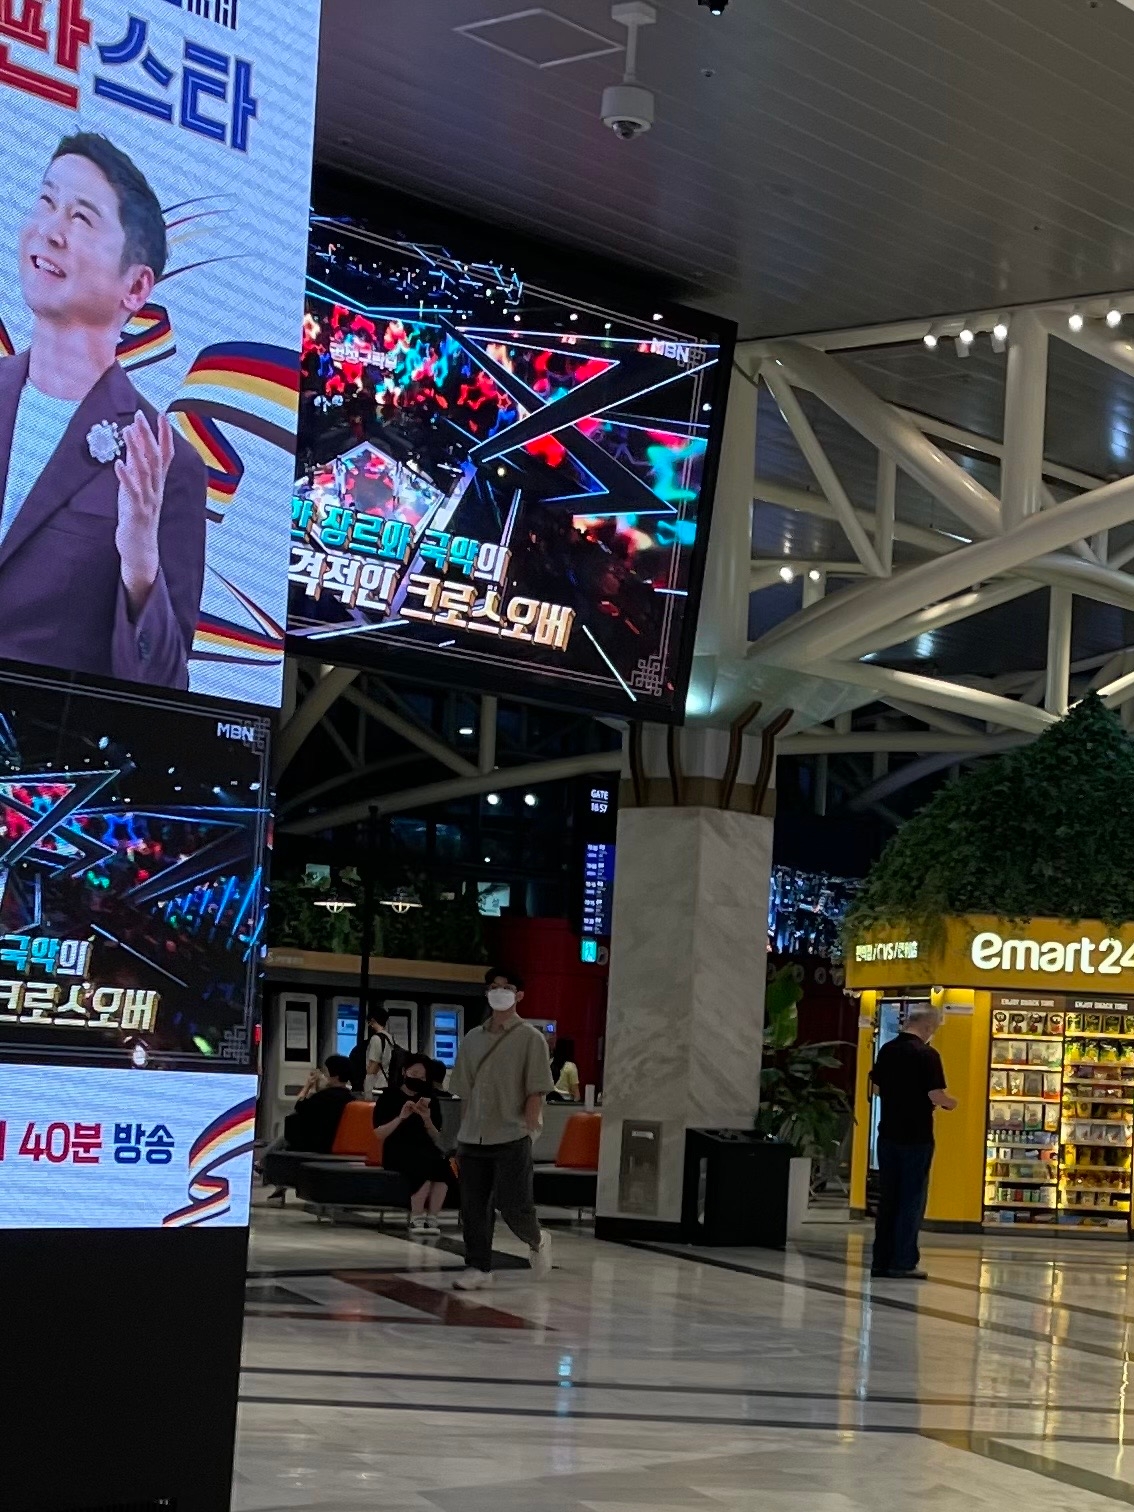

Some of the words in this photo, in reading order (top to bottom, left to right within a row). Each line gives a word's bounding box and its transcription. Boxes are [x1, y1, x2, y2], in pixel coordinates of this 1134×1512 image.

[654, 337, 689, 362] MBN
[321, 504, 414, 562] 장르와
[420, 528, 511, 582] 국악의
[400, 573, 575, 651] 크로스오버
[217, 722, 255, 742] MBN
[590, 788, 609, 800] GATE
[0, 934, 94, 979] 국악의
[18, 1121, 102, 1164] 40분
[113, 1122, 175, 1164] 방송
